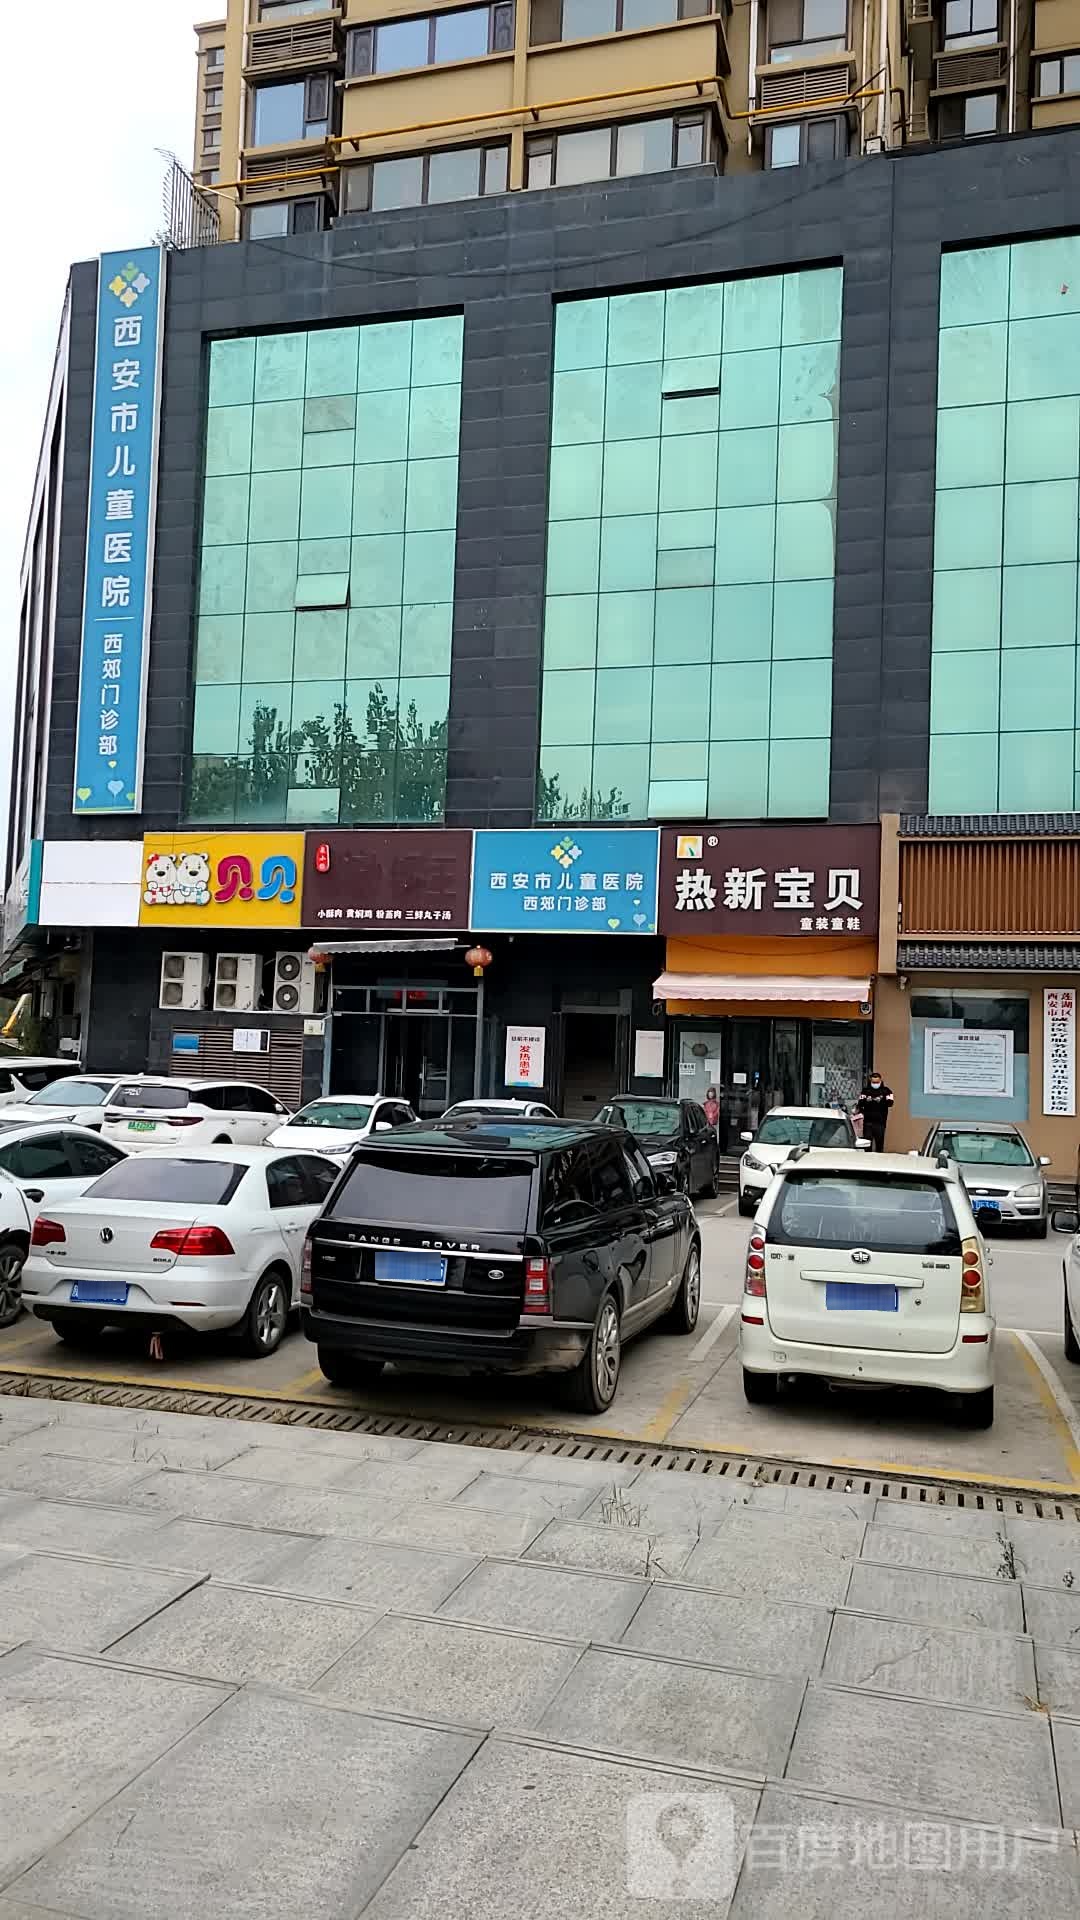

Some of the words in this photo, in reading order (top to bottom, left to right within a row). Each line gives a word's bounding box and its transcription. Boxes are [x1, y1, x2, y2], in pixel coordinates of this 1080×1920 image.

[101, 315, 143, 608] 西安市儿童医院
[98, 633, 123, 756] 西郊门诊部
[490, 872, 644, 891] 西安市儿童医院
[675, 867, 864, 911] 热新宝贝
[523, 896, 607, 911] 西郊门诊部
[317, 909, 343, 919] 小酥肉
[346, 909, 373, 919] 黄焖鸡
[376, 910, 402, 919] 粉蒸肉
[405, 910, 451, 920] 三鲜丸子汤
[800, 917, 861, 931] 童装童鞋
[348, 1233, 401, 1245] RANGE
[421, 1240, 481, 1251] ROVER
